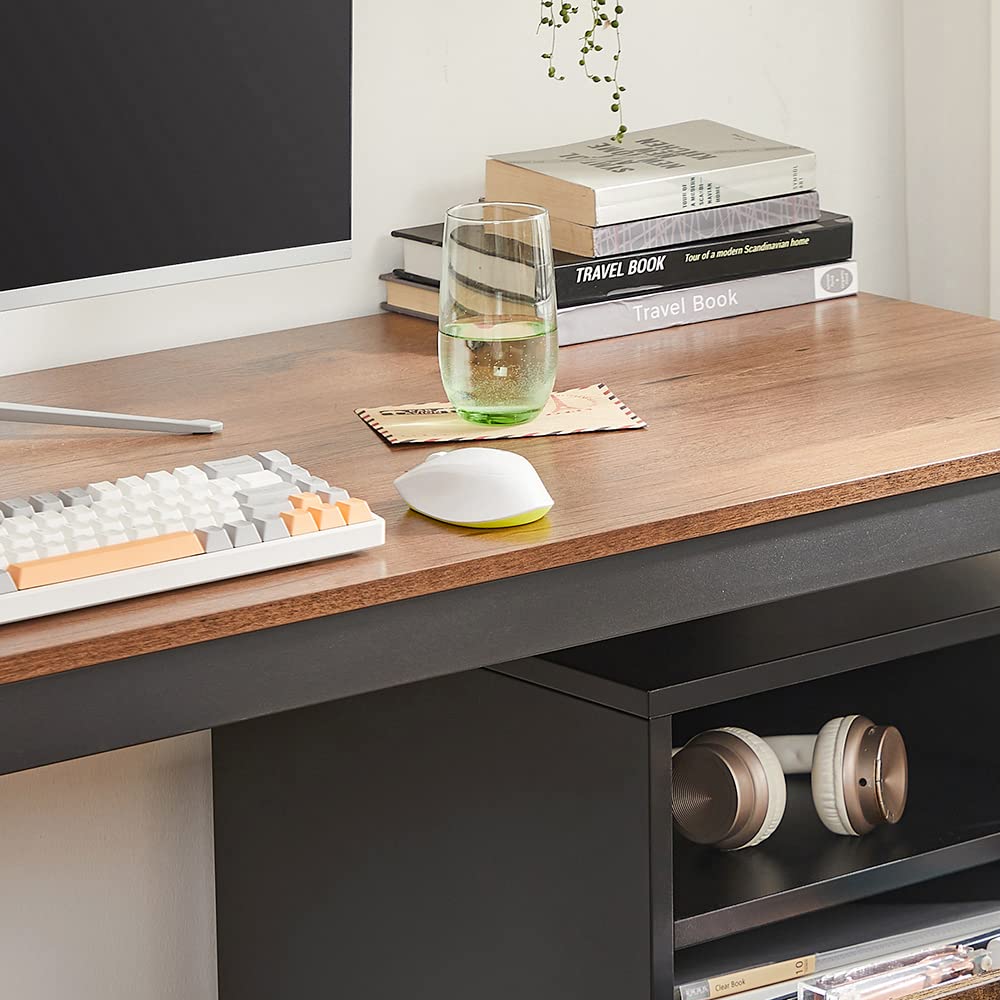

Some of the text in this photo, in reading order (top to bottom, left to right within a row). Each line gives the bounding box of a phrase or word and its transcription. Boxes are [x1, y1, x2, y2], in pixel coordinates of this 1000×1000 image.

[684, 236, 810, 263] Tour of a modern Scandinavian home
[576, 254, 667, 284] TRAVEL BOOK
[632, 290, 738, 322] Travel Book
[715, 982, 730, 992] Clear
[731, 978, 746, 988] Book
